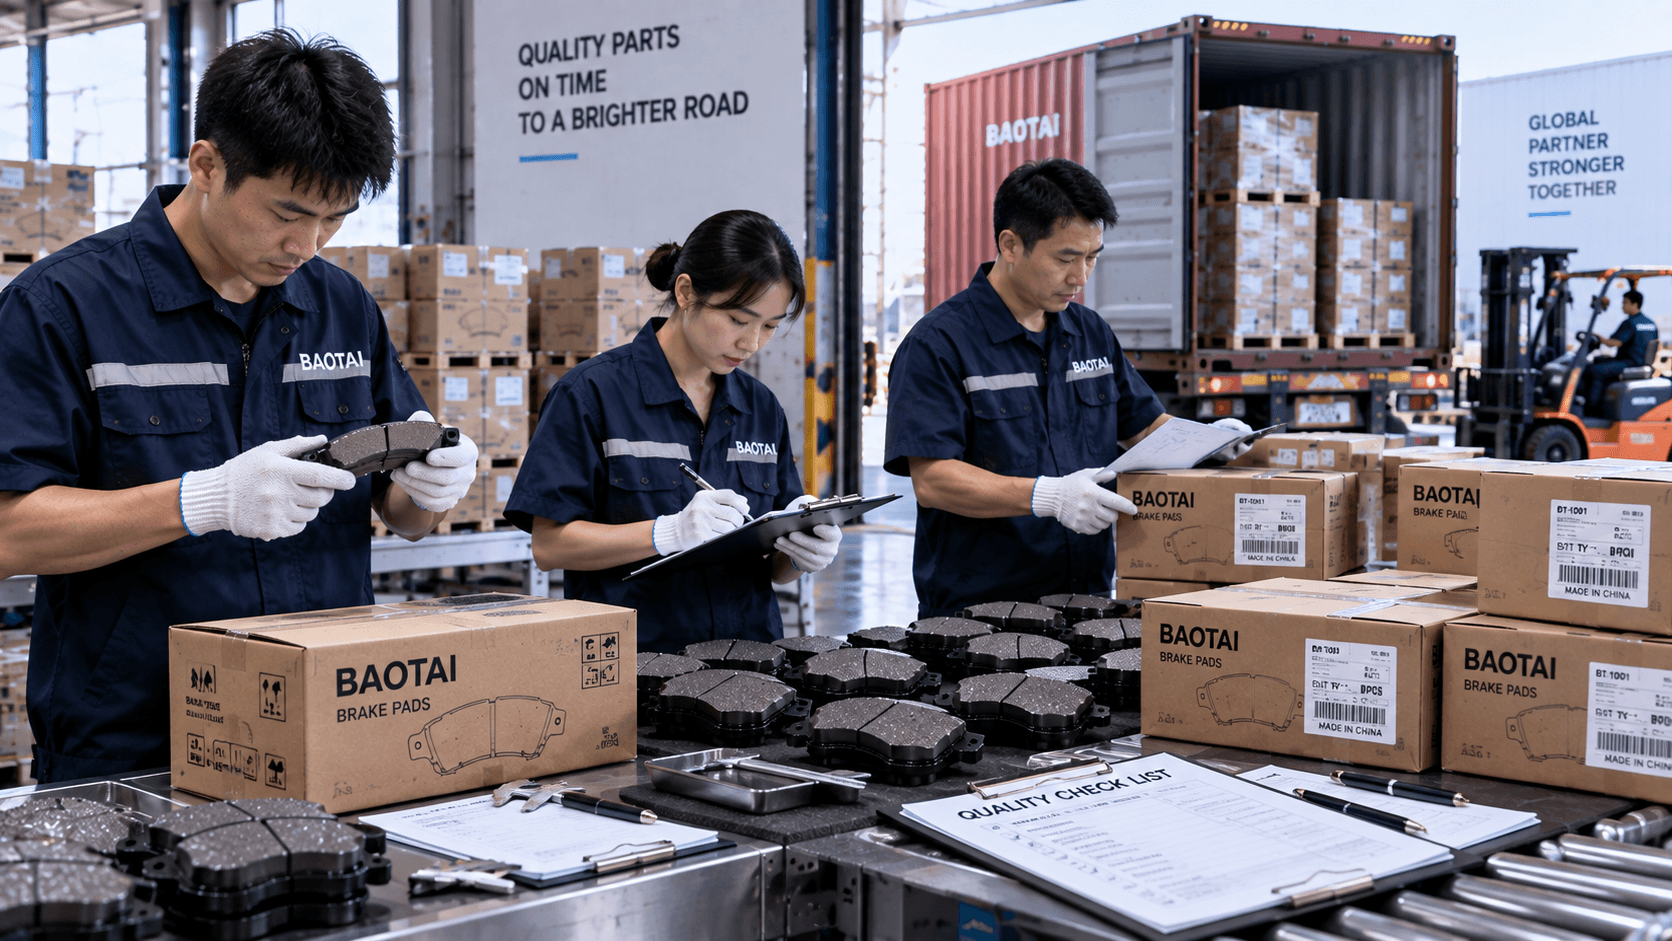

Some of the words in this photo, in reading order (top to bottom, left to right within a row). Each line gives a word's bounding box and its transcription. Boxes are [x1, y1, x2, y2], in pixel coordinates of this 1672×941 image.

[518, 33, 605, 67] QUALITY
[612, 24, 680, 55] PARTS
[518, 75, 549, 100] ON
[556, 69, 607, 97] TIME
[518, 111, 546, 134] TO
[551, 109, 566, 132] A
[571, 98, 677, 130] BRIGHTER
[684, 91, 749, 120] ROAD
[1529, 109, 1600, 131] GLOBAL
[985, 112, 1061, 148] BAOTAI
[1529, 132, 1609, 154] PARTNER
[1528, 155, 1625, 177] STRONGER
[1527, 180, 1616, 199] TOGETHER
[299, 350, 364, 371] BAOTAI
[1072, 356, 1109, 373] BAOTAI
[1132, 490, 1195, 508] BAOTAI
[1413, 484, 1480, 509] BAOTAI
[1413, 507, 1444, 518] BRAKE
[1591, 588, 1600, 597] IN
[1603, 589, 1631, 600] CHINA
[1160, 623, 1239, 651] BAOTAI
[1160, 651, 1193, 665] BRAKE
[1195, 655, 1222, 669] PADS
[1464, 647, 1556, 680] BAOTAI
[336, 654, 456, 698] BAOTAI
[1464, 679, 1503, 695] BRAKE
[1507, 684, 1537, 699] PADS
[337, 702, 387, 723] BRAKE
[392, 697, 431, 715] PADS
[1318, 721, 1342, 732] MADE
[1344, 725, 1353, 733] IN
[1355, 726, 1383, 737] CHINA
[1604, 754, 1631, 766] MADE
[1634, 758, 1644, 768] IN
[957, 794, 1051, 820] QUALITY
[1054, 779, 1128, 800] CHECK
[1127, 768, 1172, 786] LIST
